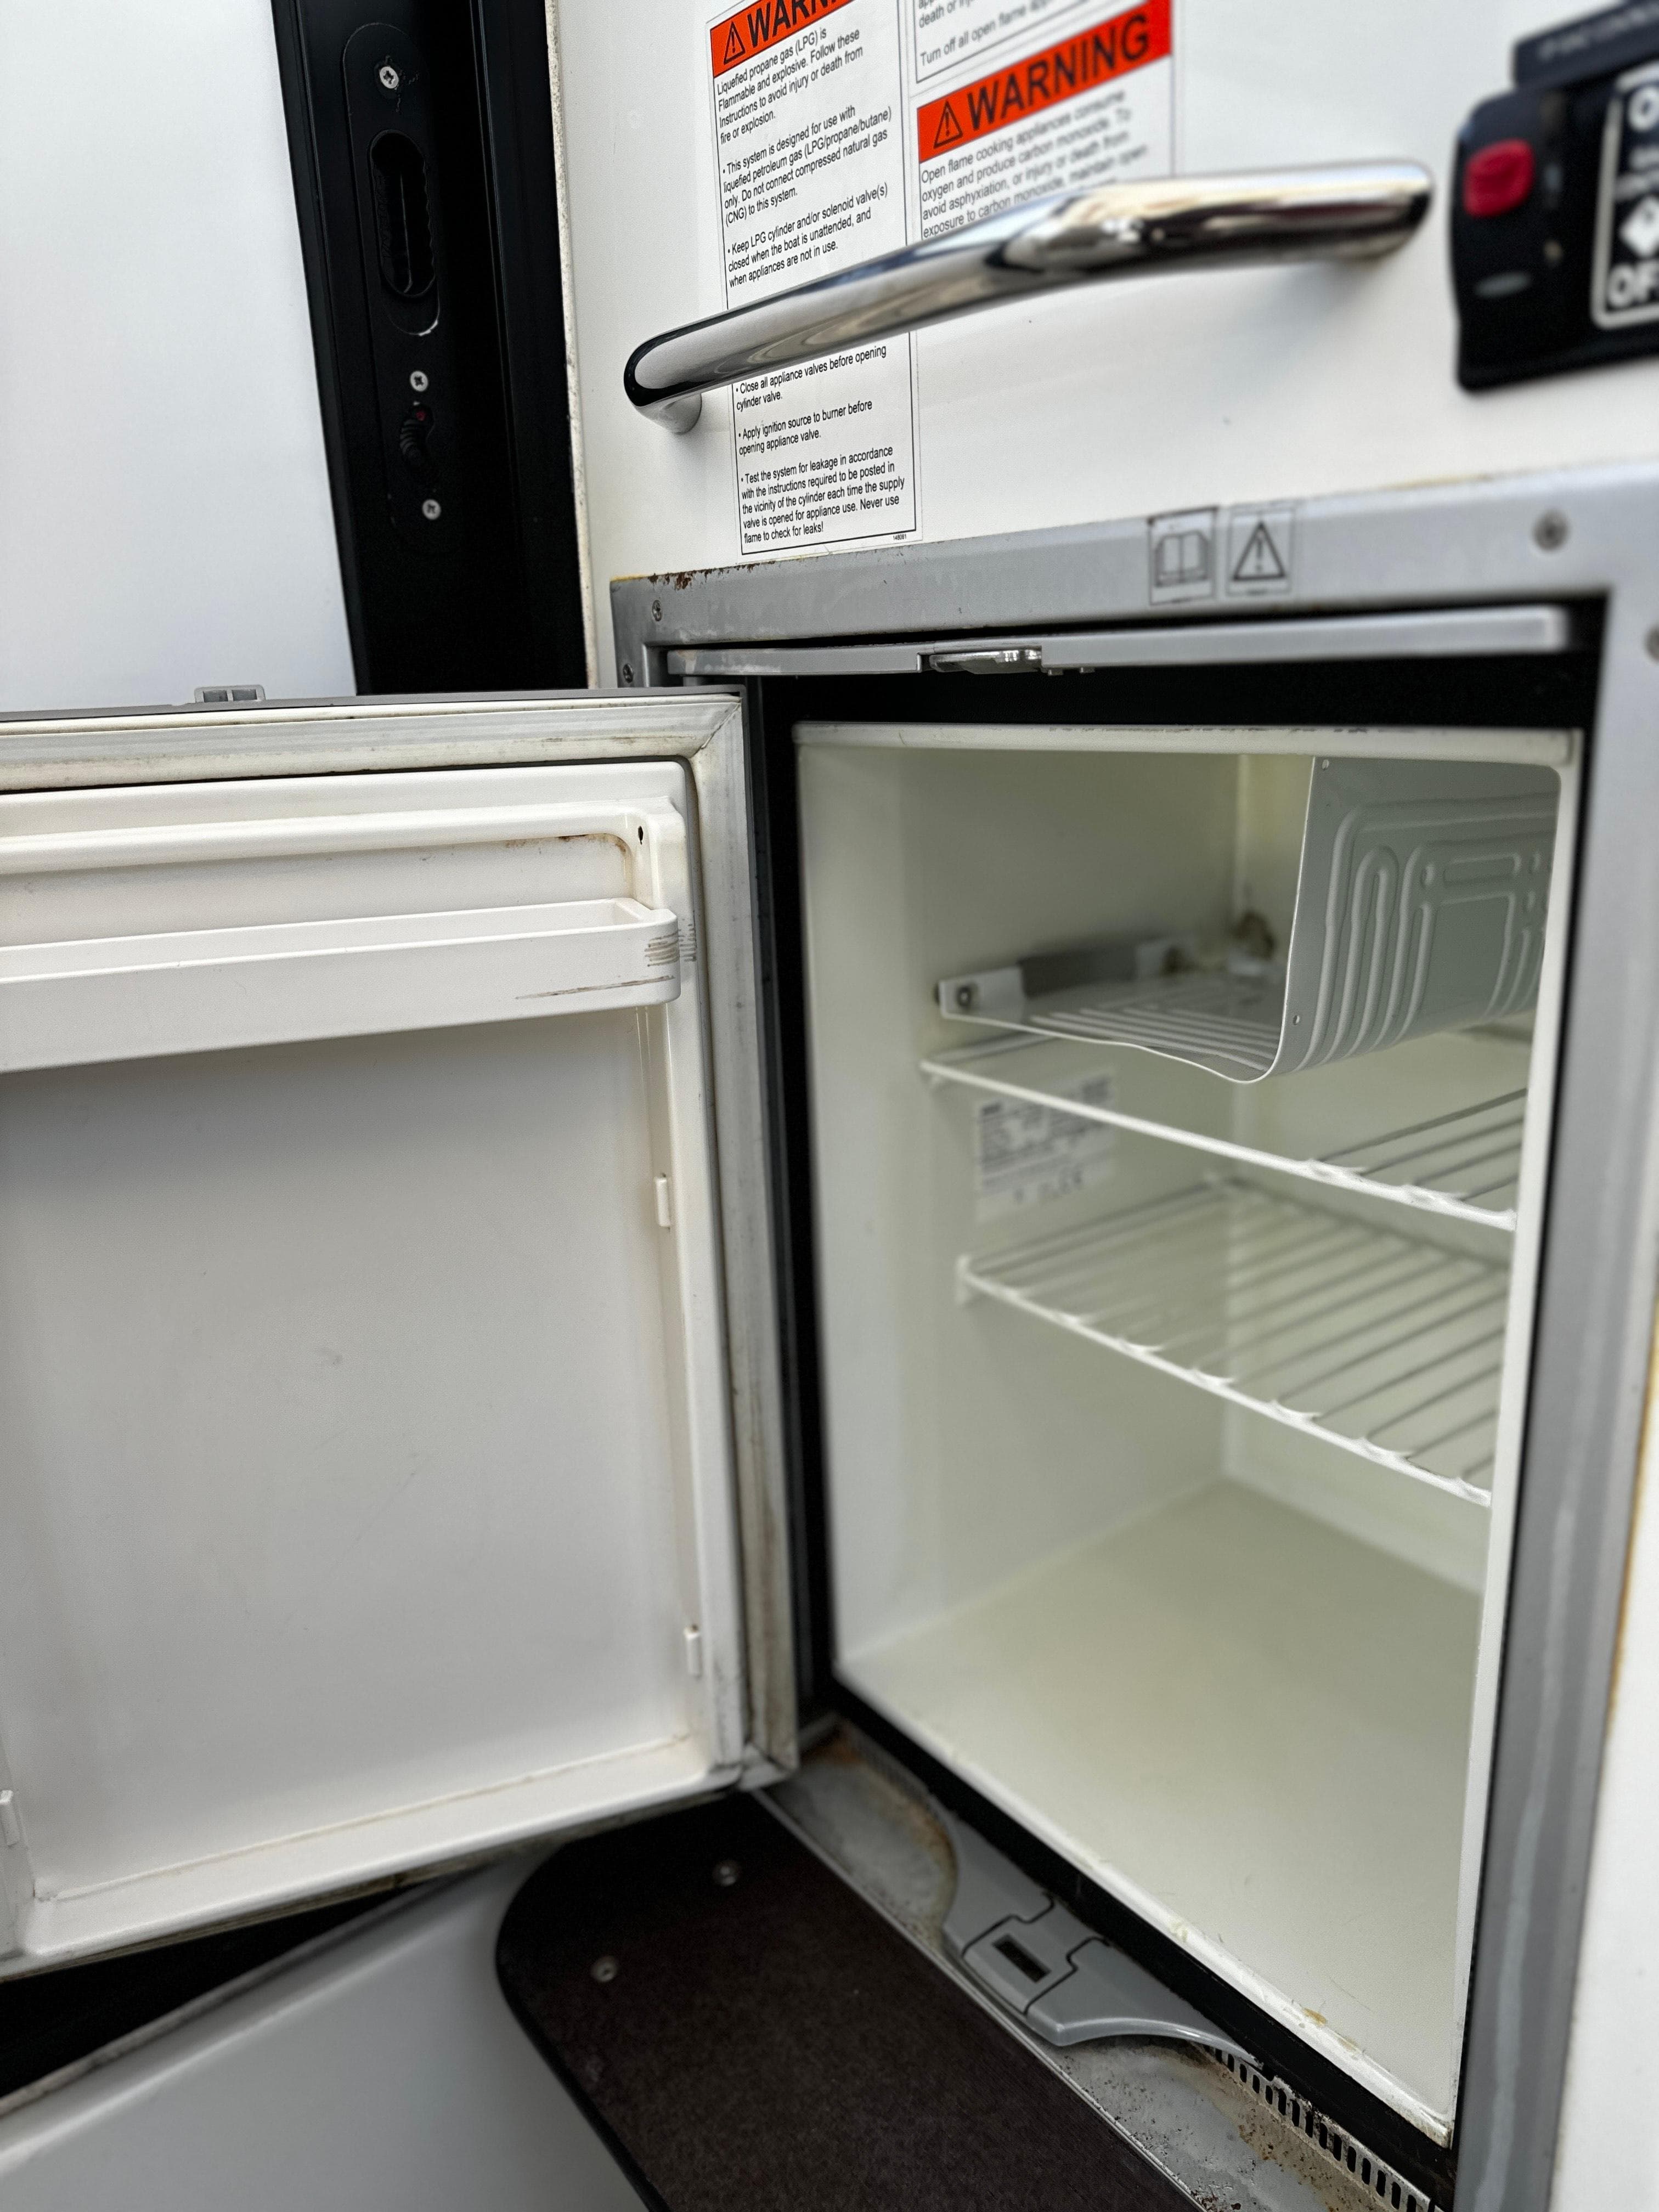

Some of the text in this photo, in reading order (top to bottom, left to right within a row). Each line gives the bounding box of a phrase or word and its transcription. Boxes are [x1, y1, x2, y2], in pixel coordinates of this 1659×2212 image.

[919, 5, 944, 28] death
[717, 29, 827, 96] Liquefied propane gas (LPG) is
[921, 48, 941, 66] Turn
[944, 37, 956, 55] off
[958, 31, 969, 48] all
[972, 21, 996, 42] open
[719, 30, 860, 112] Flammable and explosive. Follow these
[720, 47, 863, 129] Instructions to avoid injury or death from
[967, 14, 1150, 131] WARNING
[720, 111, 776, 145] fire or explosion.
[724, 106, 892, 194] liquefied petroleum gas (LPG/propane/butane)
[727, 105, 856, 175] This system is designed for use with
[725, 129, 888, 210] only. Do not connect compressed natural gas
[921, 166, 946, 184] Open
[948, 154, 973, 173] flame
[975, 137, 1014, 161] cooking
[922, 181, 954, 202] oxygen
[957, 170, 974, 189] and
[977, 156, 1016, 184] produce
[1018, 140, 1054, 163] carbon
[726, 188, 798, 228] (CNG) to this system.
[732, 182, 888, 256] Keep LPG cylinder and/or solenoid valve(s)
[923, 200, 946, 221] avoid
[949, 179, 1009, 211] asphyxiation,
[1012, 172, 1023, 185] or
[923, 215, 964, 238] exposure
[966, 210, 976, 223] to
[978, 197, 1011, 218] carbon
[729, 207, 871, 273] closed when the boat is unattended, and
[729, 241, 838, 289] when appliances are not in use.
[740, 382, 759, 394] Close
[770, 369, 803, 388] appliance
[804, 363, 828, 377] valves
[830, 356, 854, 370] before
[855, 346, 887, 365] opening
[736, 391, 783, 413] cylinder valve.
[743, 400, 873, 442] Apply ignition source to burner before
[739, 429, 821, 458] opening appliance valve.
[745, 447, 893, 484] Test the system for leakage in accordance
[742, 461, 895, 500] with the instructions required to be posted in
[742, 476, 905, 515] the vicinity of the cylinder each time the supply
[743, 495, 900, 529] valve is opened for appliance use. Never use
[744, 521, 823, 544] flame to check for leaks!
